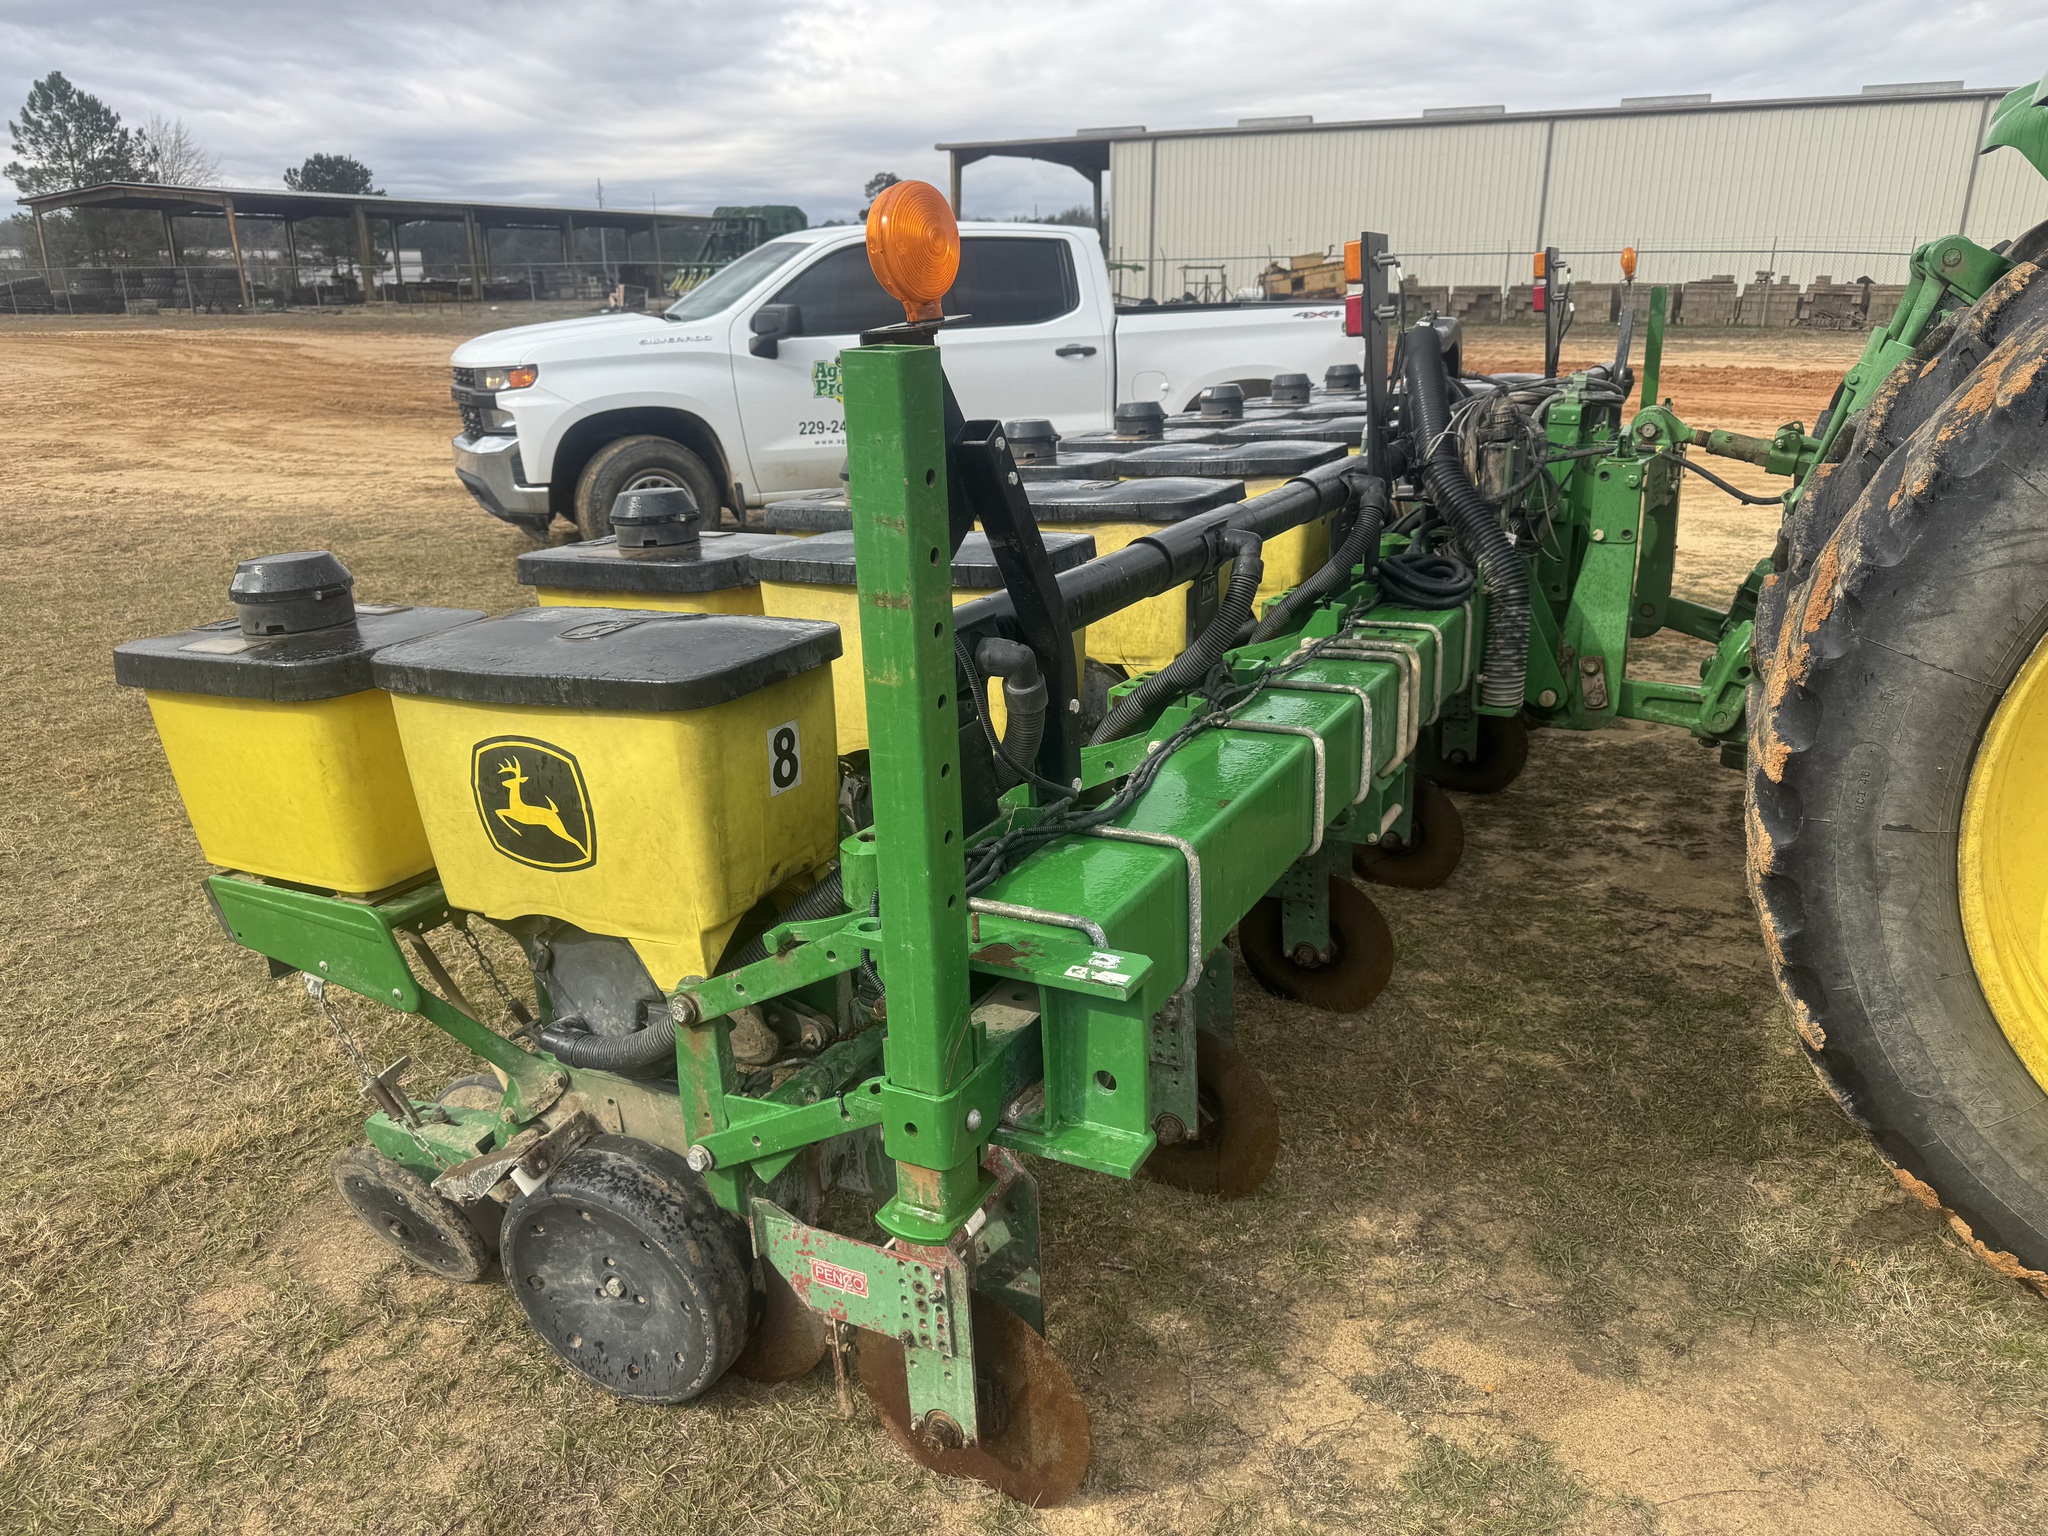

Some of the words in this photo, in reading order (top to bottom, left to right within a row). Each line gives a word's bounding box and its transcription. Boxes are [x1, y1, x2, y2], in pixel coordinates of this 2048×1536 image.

[639, 335, 713, 345] SILVERADO
[814, 362, 842, 382] Ag
[773, 727, 799, 789] 8
[815, 1265, 864, 1291] PENCO
